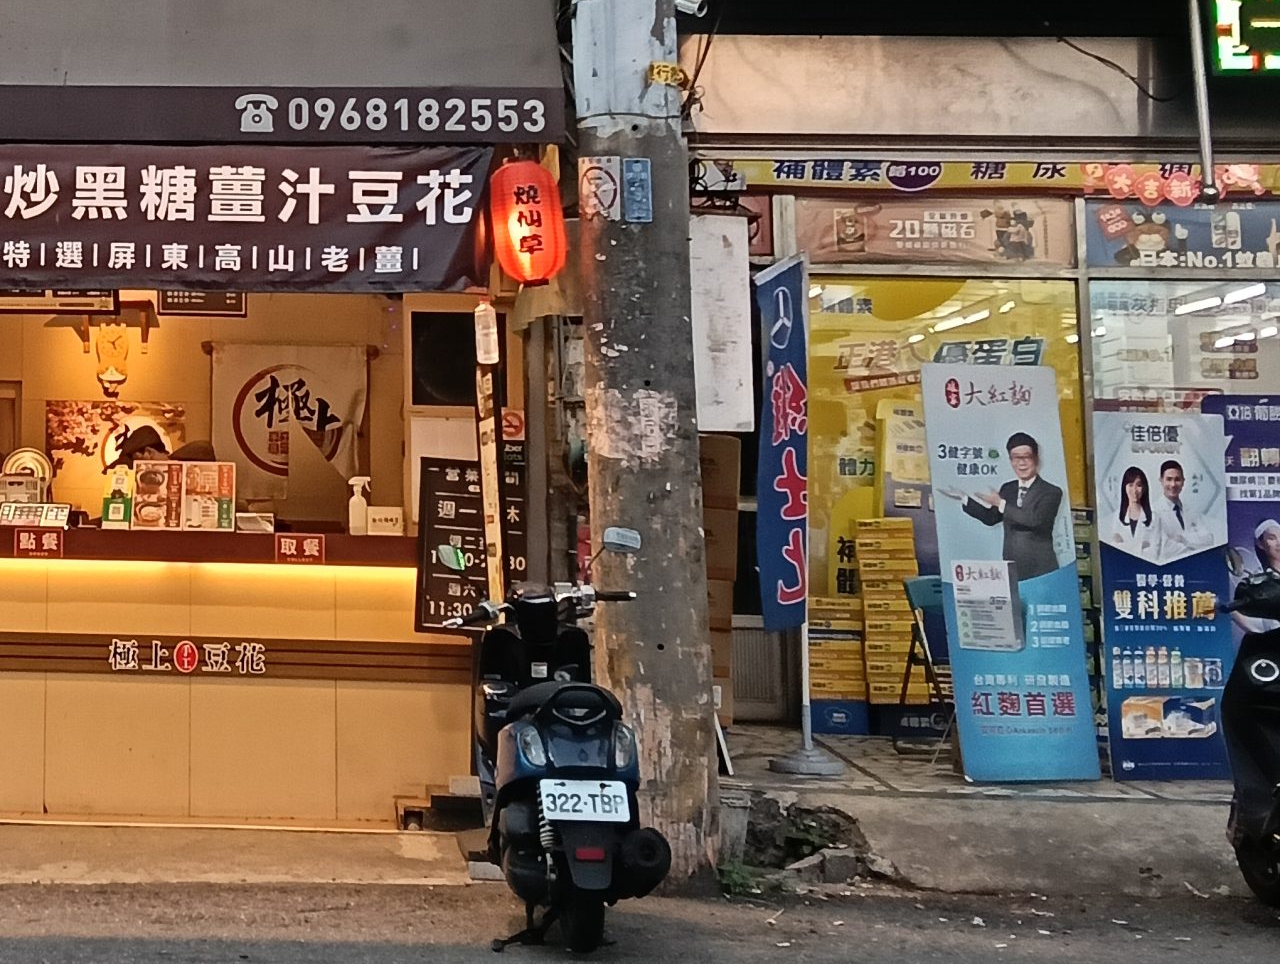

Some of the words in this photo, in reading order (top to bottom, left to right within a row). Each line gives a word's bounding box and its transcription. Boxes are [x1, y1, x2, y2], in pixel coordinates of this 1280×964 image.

[288, 98, 546, 132] 0968182553
[514, 185, 544, 255] 燒仙草
[1131, 425, 1178, 442] 佳倍優
[19, 532, 58, 550] 點餐
[280, 538, 320, 556] 取餐
[1113, 590, 1216, 620] 雙科推薦
[971, 691, 1076, 716] 紅麴首選
